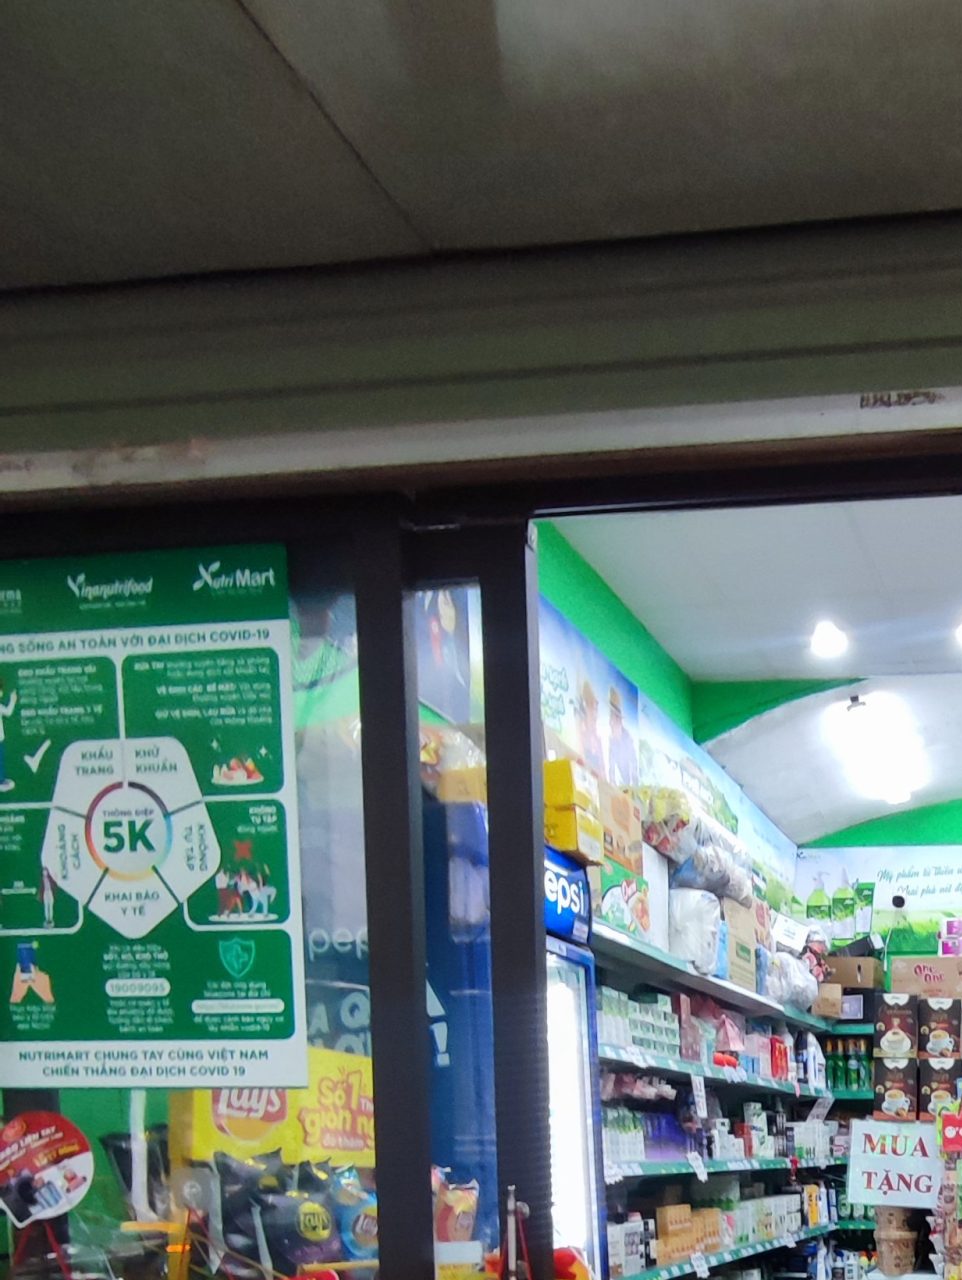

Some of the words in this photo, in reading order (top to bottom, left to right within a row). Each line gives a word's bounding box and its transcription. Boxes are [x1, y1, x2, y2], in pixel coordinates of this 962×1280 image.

[210, 628, 270, 643] COVID-19
[103, 819, 155, 853] 5K
[544, 869, 586, 914] epsi
[19, 1049, 91, 1061] NUTRIMART
[94, 1049, 138, 1061] CHUNG
[143, 1050, 164, 1060] TAY
[240, 1049, 269, 1060] NAM
[190, 1065, 229, 1076] COVID
[233, 1065, 246, 1076] 19
[863, 1133, 929, 1158] MUA
[862, 1169, 933, 1196] TẶNG
